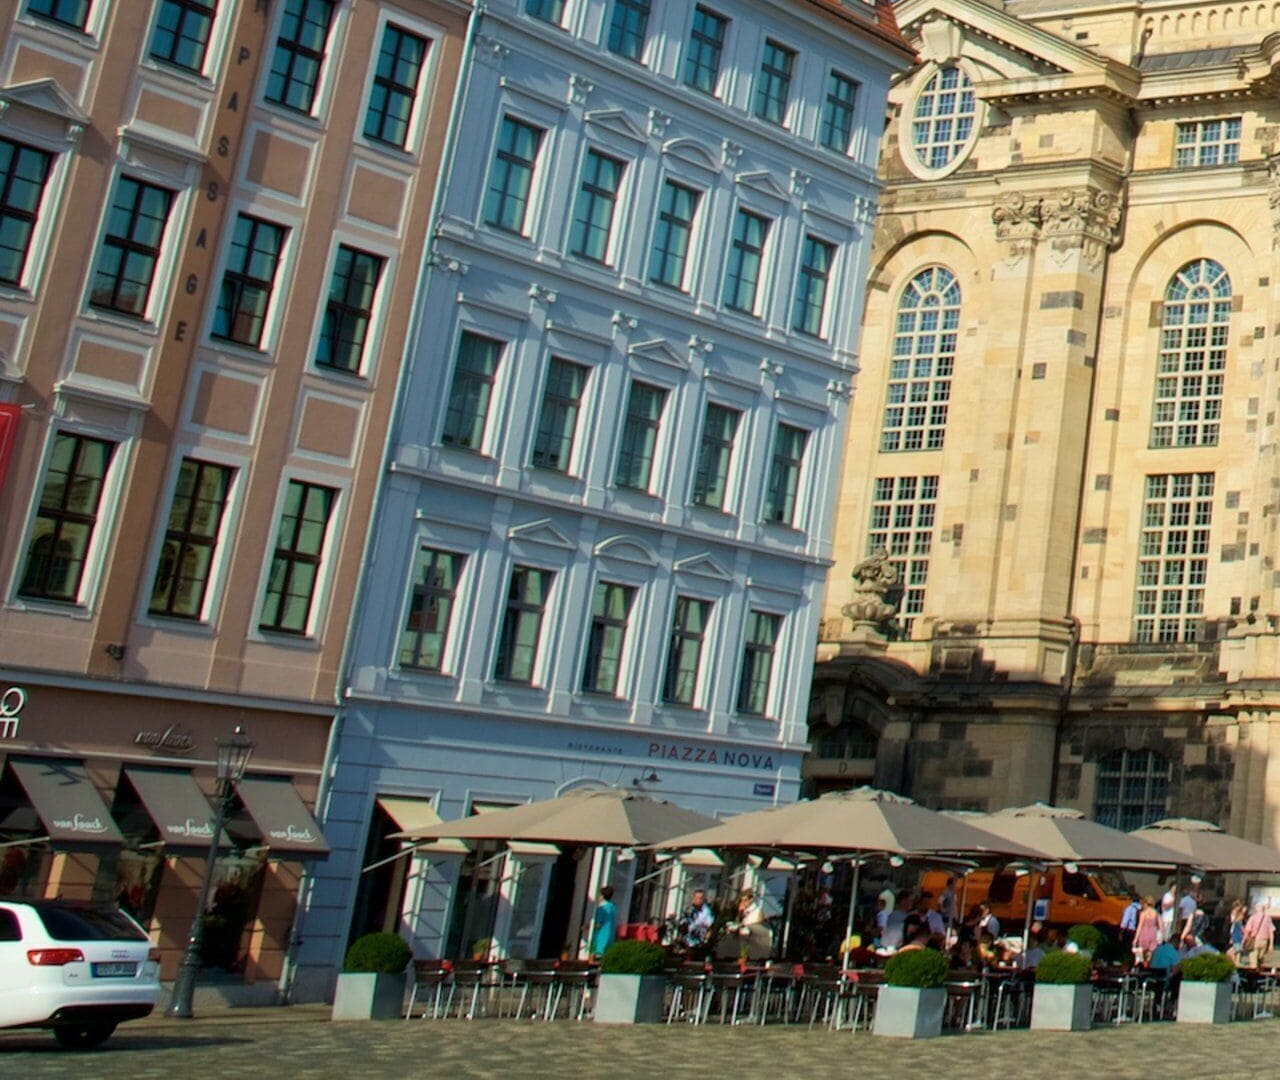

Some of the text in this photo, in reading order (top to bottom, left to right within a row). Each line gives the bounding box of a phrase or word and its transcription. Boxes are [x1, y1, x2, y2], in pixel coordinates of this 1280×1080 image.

[174, 46, 250, 342] PASSAGE
[648, 743, 718, 764] PIAZZA
[723, 751, 774, 770] NOVA
[53, 820, 73, 828] van
